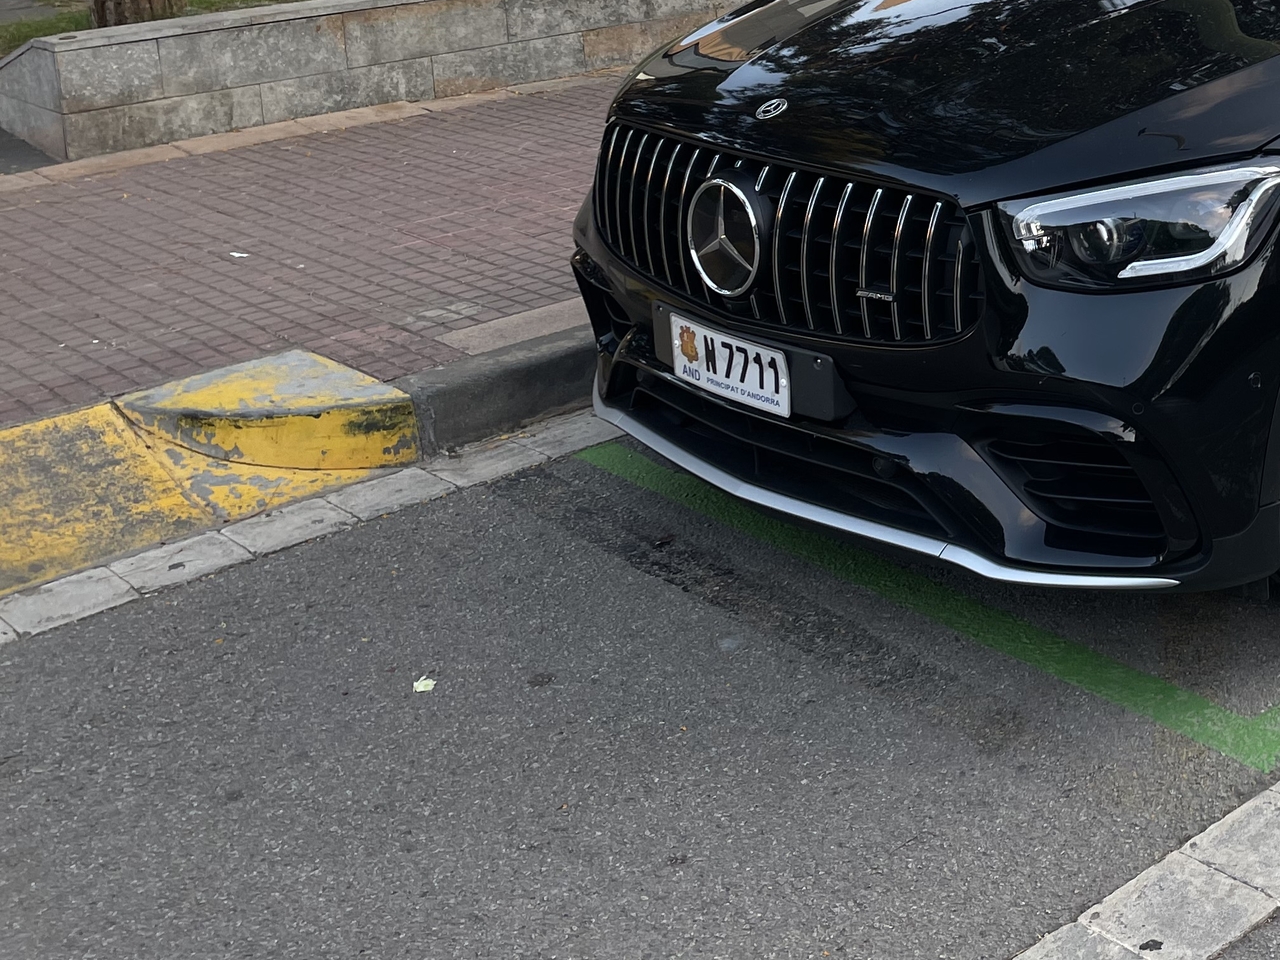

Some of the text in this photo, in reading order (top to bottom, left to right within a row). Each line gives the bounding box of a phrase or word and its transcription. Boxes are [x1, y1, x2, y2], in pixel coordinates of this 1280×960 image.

[868, 292, 893, 301] AMG
[682, 364, 701, 381] AND
[706, 377, 781, 407] PRINCIPAT D'ANDORRA
